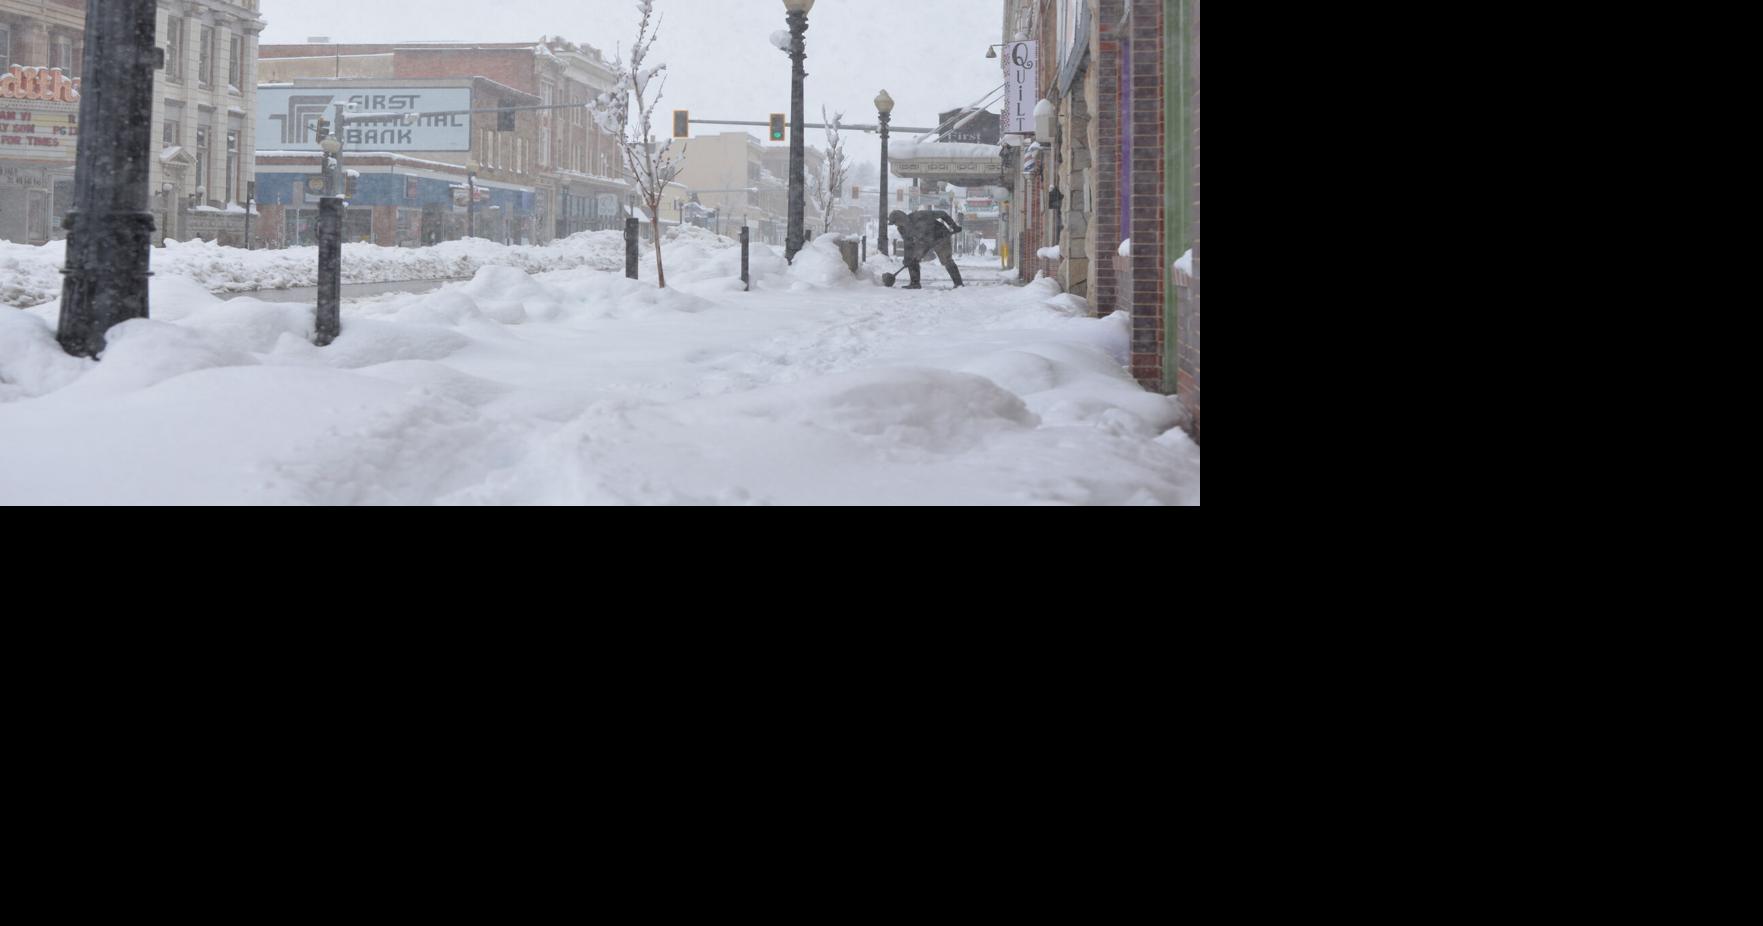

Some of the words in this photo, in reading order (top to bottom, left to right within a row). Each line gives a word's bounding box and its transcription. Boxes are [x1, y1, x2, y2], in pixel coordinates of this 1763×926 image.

[348, 94, 421, 110] FIRST
[26, 136, 59, 147] TIMES
[346, 128, 412, 145] BANK
